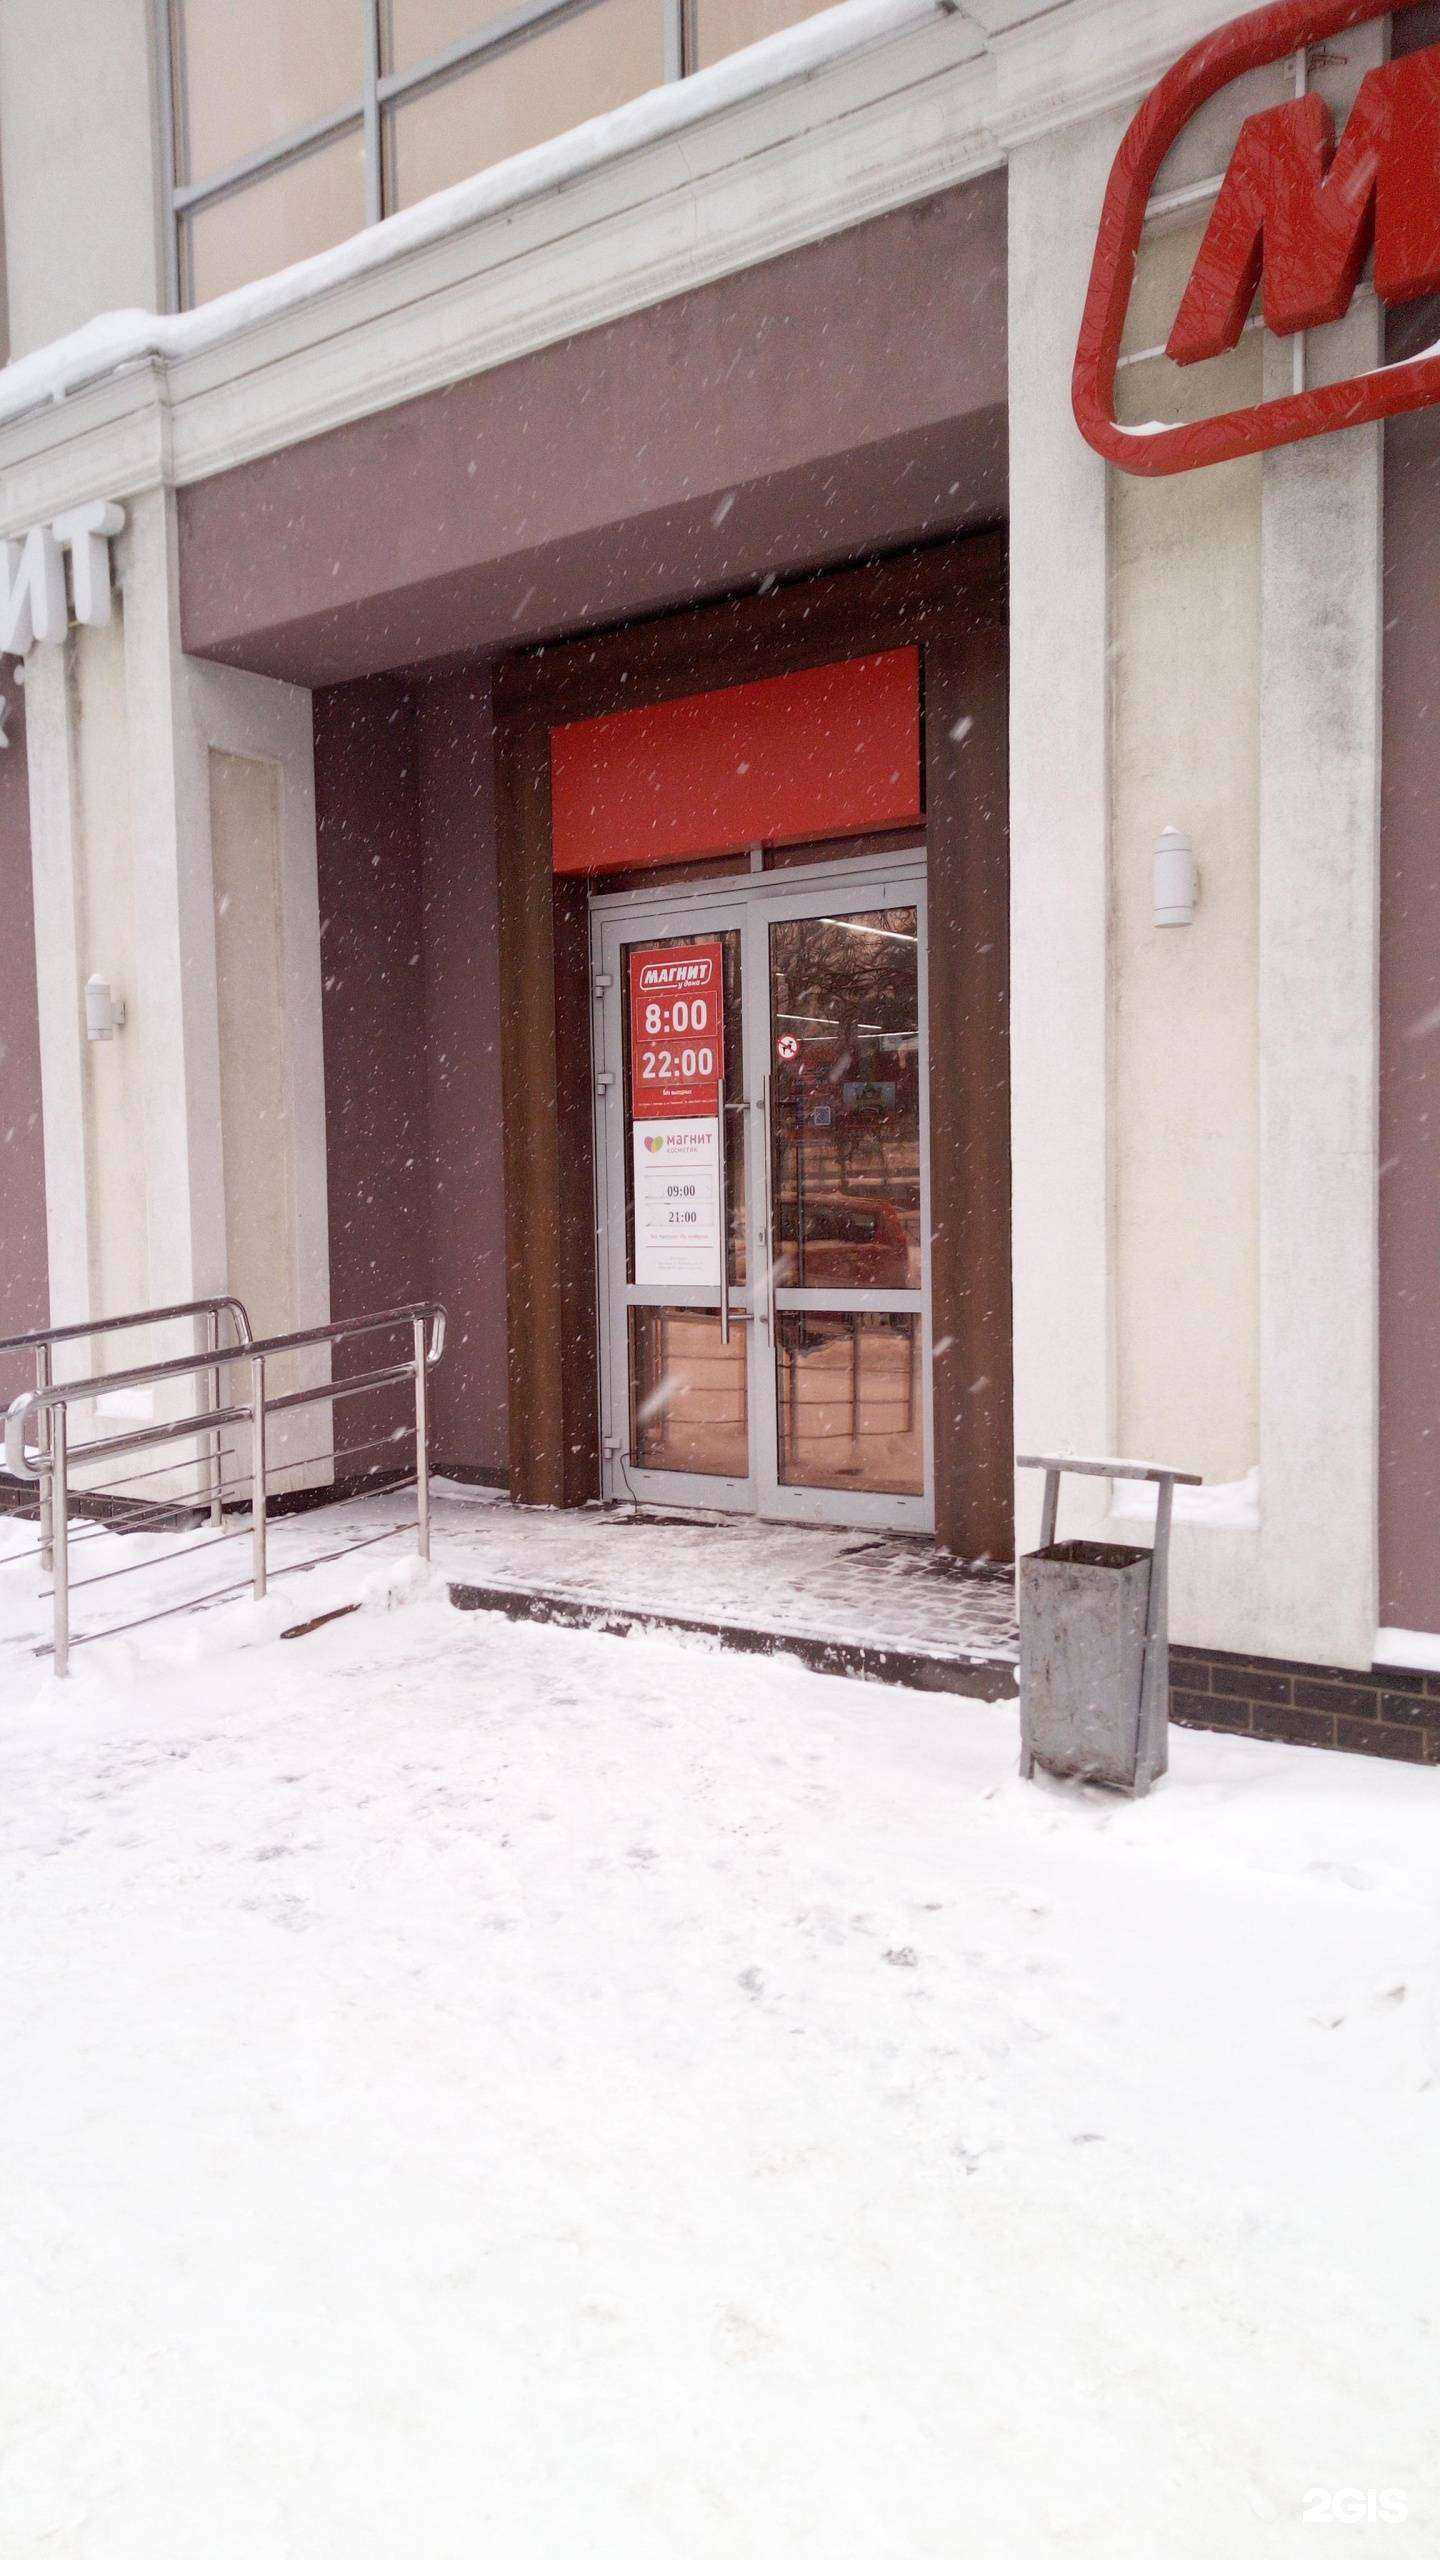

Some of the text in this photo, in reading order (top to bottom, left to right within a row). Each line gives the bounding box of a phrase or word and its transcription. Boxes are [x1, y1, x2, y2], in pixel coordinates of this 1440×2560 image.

[644, 964, 708, 984] МАГНИТ
[645, 999, 708, 1034] 8:00
[642, 1047, 713, 1079] 22:00
[666, 1133, 713, 1146] магнит
[667, 1185, 696, 1197] 09:00
[668, 1212, 697, 1223] 21:00
